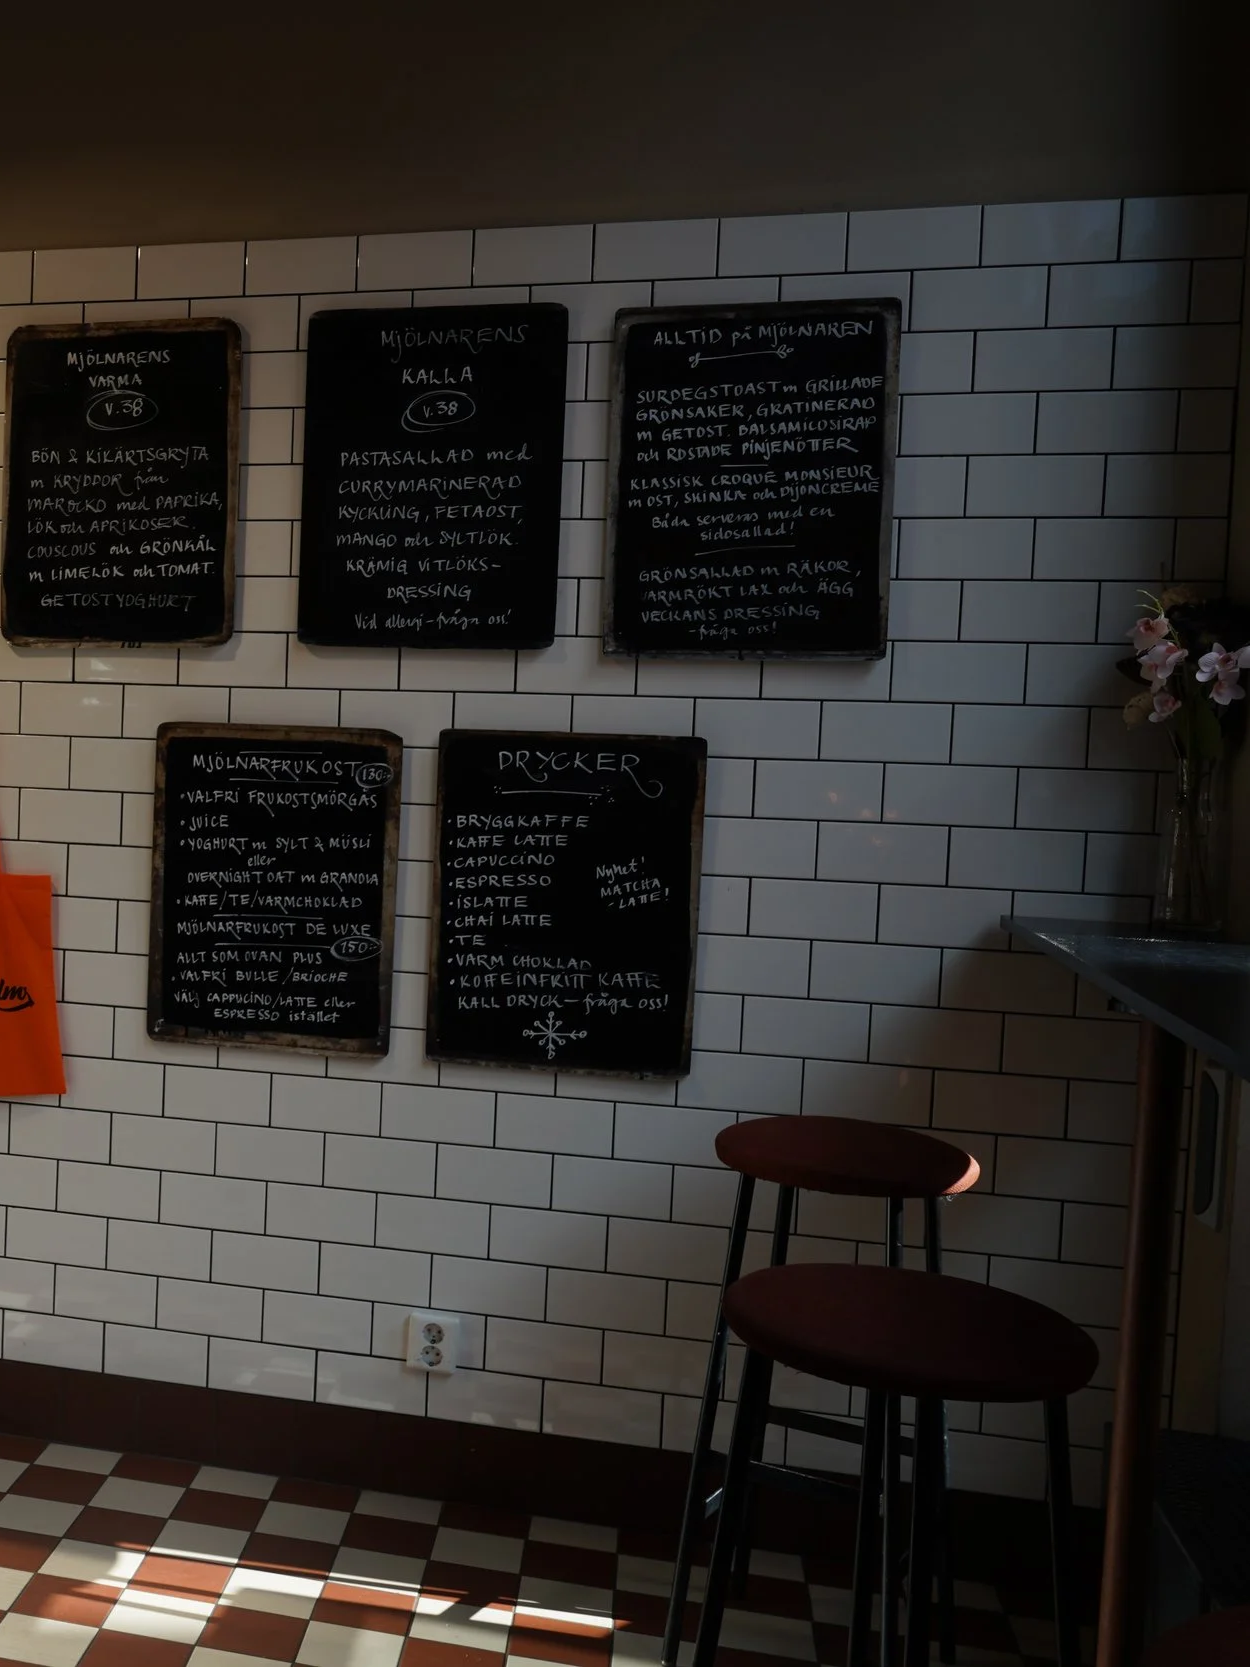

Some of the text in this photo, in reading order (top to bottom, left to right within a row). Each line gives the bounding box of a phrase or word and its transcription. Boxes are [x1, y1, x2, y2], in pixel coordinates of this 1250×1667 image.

[653, 319, 874, 347] ALLTID på MJÖLNAREN
[381, 324, 529, 364] MJÖLNARENS
[67, 349, 171, 372] MJÖLNARENS
[88, 373, 143, 391] VARMA
[401, 365, 474, 385] KALLA
[636, 374, 884, 405] SURDEGSTOAST m GRILLADE
[756, 396, 876, 418] GRATINERAD
[637, 430, 653, 442] m
[31, 446, 210, 468] BÖN & KIKÄRTSGRYTA
[340, 443, 533, 468] PASTASALLAD med
[637, 449, 659, 462] och
[741, 436, 860, 461] PINJENÖTTER
[30, 478, 44, 489] m
[53, 472, 133, 496] KRYDDOR
[338, 474, 522, 501] CURRYMARINERAD
[630, 464, 882, 490] KLASSISK CROQUE MONSIEUR
[27, 498, 107, 516] MAROCKO
[116, 498, 150, 512] med
[628, 498, 642, 508] m
[684, 489, 747, 504] SKINKA
[752, 487, 777, 501] och
[27, 517, 60, 534] LÖK
[60, 523, 85, 534] och
[651, 505, 836, 529] Båda serveras med en
[27, 534, 216, 559] COUSCOUS och GRÖNKÅL
[336, 533, 398, 548] MANGO
[404, 532, 434, 547] och
[29, 571, 44, 583] m
[51, 562, 125, 580] LIMELÖK
[133, 566, 153, 578] och
[346, 556, 409, 578] KRÄMIG
[639, 563, 755, 584] GRÖNSALLAD
[760, 566, 781, 577] m
[387, 583, 472, 604] DRESSING
[740, 583, 773, 597] LAX
[778, 582, 808, 595] och
[354, 613, 377, 630] Vid
[641, 607, 718, 625] VECKANS
[748, 621, 778, 636] oss!
[498, 750, 664, 799] DRYCKER
[247, 787, 378, 818] FRUKOSTSMÖRGÅS
[189, 813, 230, 832] JUICE
[188, 837, 250, 855] YOGHURT
[252, 840, 267, 850] m
[275, 836, 309, 853] SYLT
[329, 834, 372, 849] MÜSLI
[514, 834, 569, 847] LATTE
[247, 854, 277, 867] eller
[187, 867, 263, 889] OVERNIGHT
[267, 870, 295, 884] OAT
[301, 874, 316, 884] m
[455, 874, 552, 889] ESPRESSO
[600, 877, 662, 899] MATCHA
[177, 918, 297, 941] MJÖLNARFRUKOST
[306, 923, 327, 936] DE
[332, 924, 372, 937] LUXE
[454, 911, 553, 929] CHAI LATTE
[455, 934, 487, 947] TE
[177, 950, 323, 965] ALLT SOM OVAN PLUS
[455, 953, 592, 970] VARM CHOKLAD
[236, 970, 279, 983] BULLE
[598, 971, 662, 989] KAFFE
[174, 988, 200, 1008] VÄLJ
[324, 995, 356, 1009] eller
[458, 996, 501, 1010] KALL
[214, 1009, 341, 1024] ESPRESSO istället
